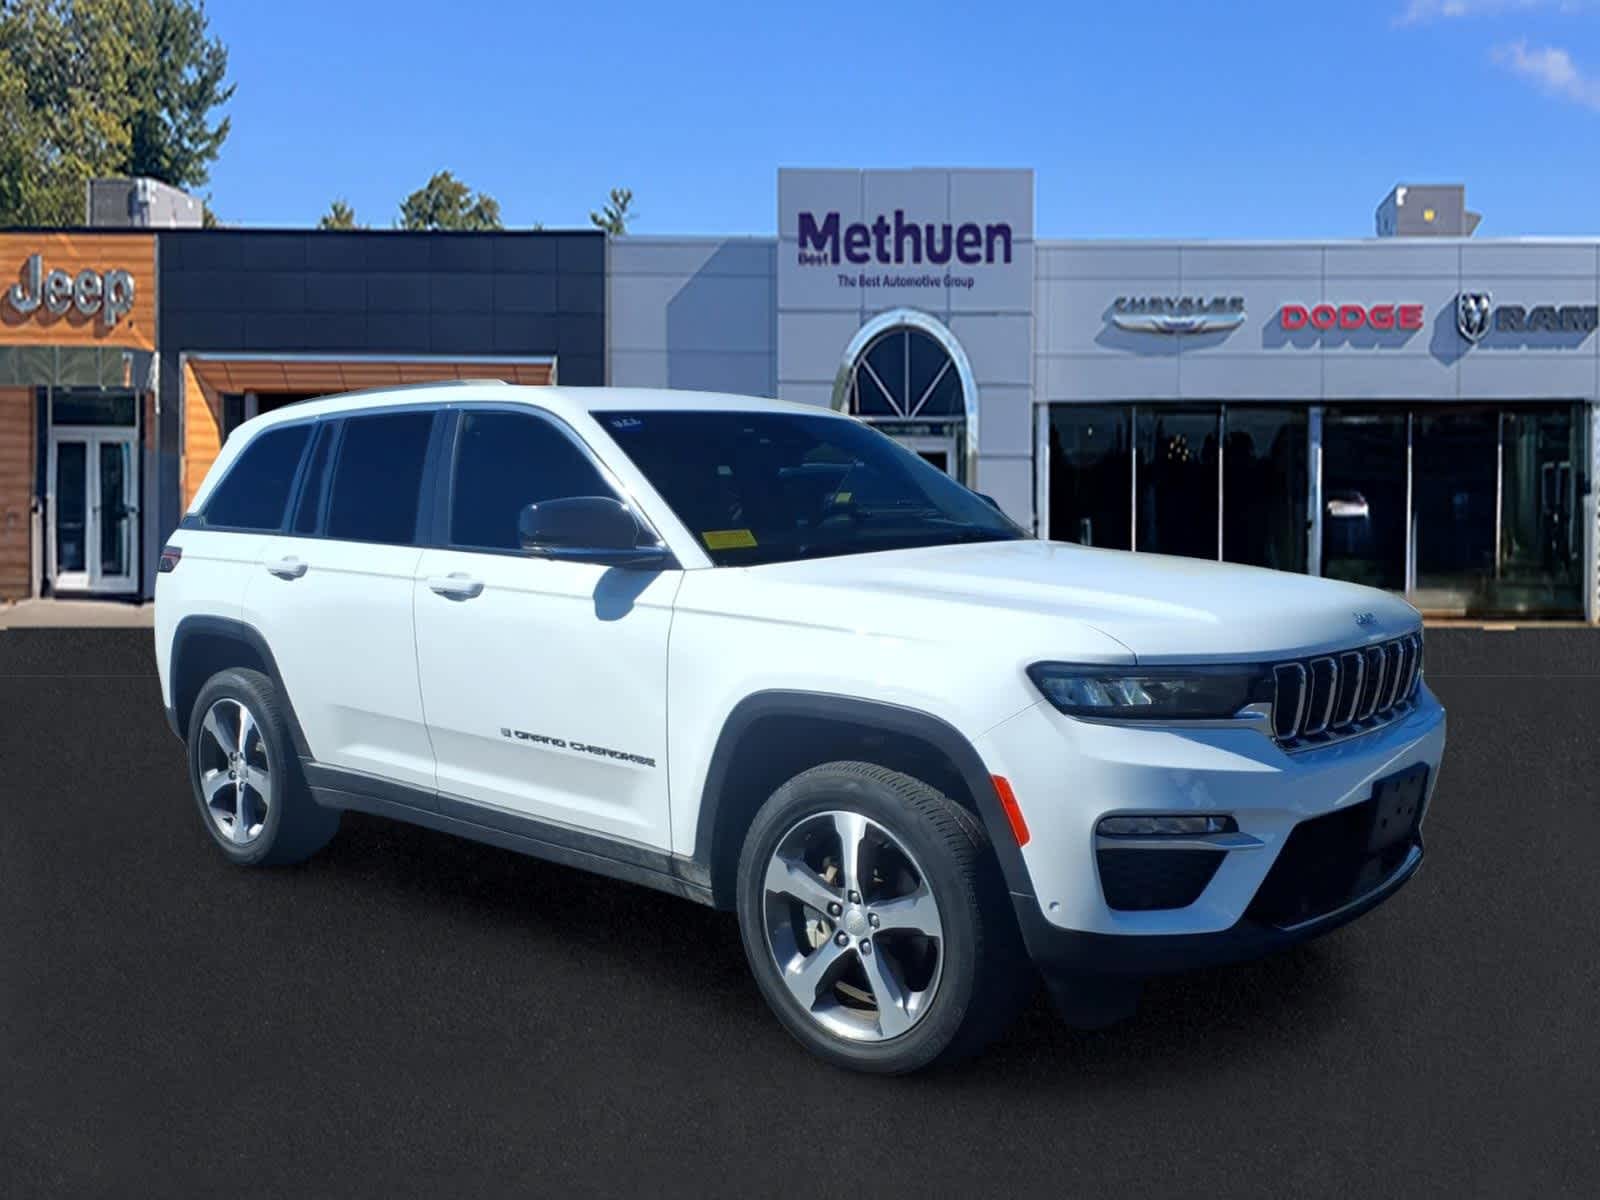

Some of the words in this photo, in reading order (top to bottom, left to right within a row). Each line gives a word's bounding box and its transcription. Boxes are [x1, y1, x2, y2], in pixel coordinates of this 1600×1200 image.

[798, 209, 1012, 265] Methuen
[9, 253, 135, 326] Jeep
[837, 274, 858, 288] The
[859, 274, 881, 288] Best
[883, 274, 941, 288] Automotive
[943, 274, 975, 290] Group
[1114, 296, 1245, 313] CHRYSLER
[1281, 304, 1424, 330] DODGE
[1496, 304, 1599, 331] RAM
